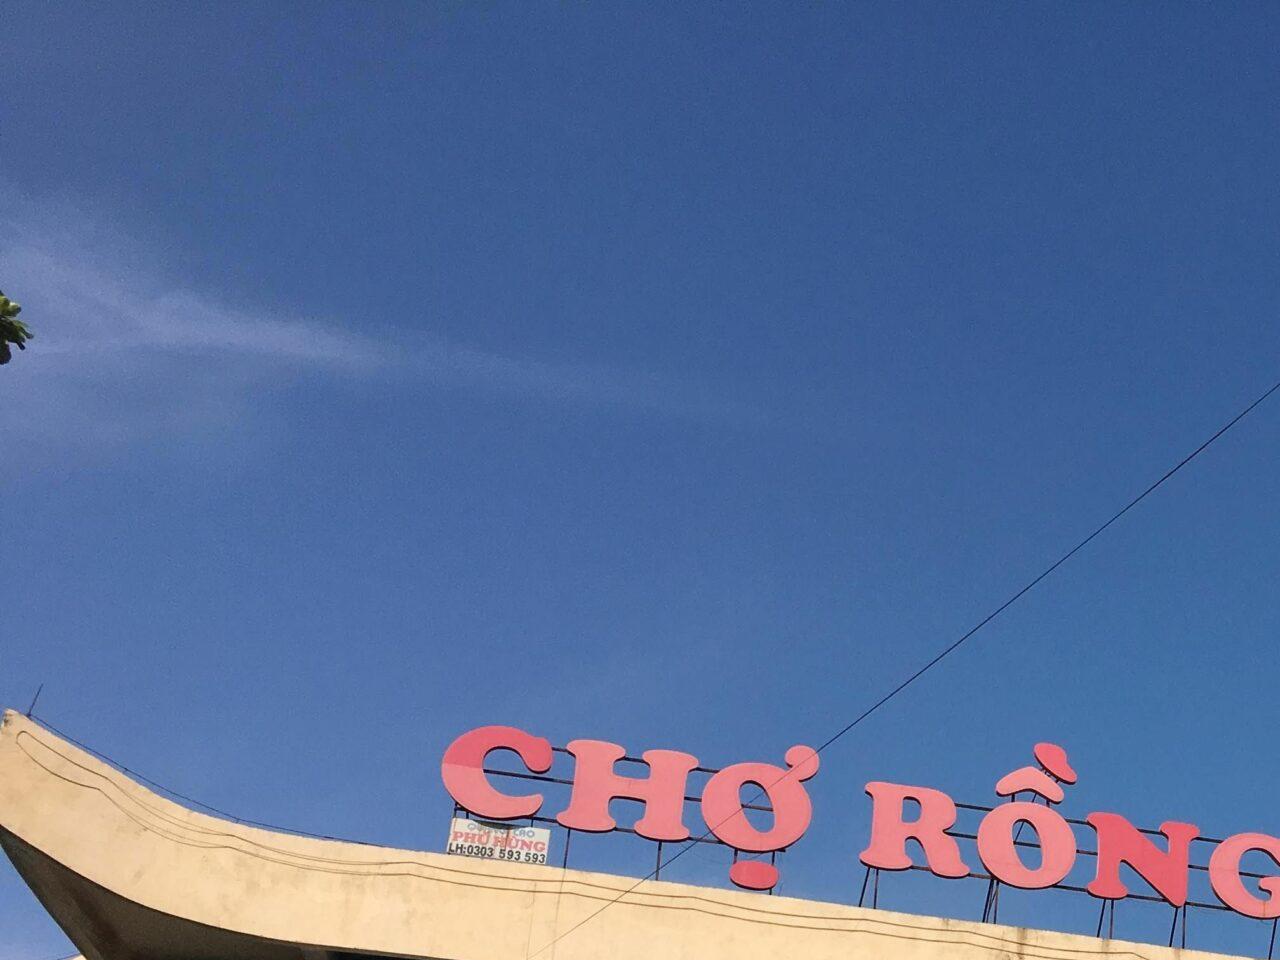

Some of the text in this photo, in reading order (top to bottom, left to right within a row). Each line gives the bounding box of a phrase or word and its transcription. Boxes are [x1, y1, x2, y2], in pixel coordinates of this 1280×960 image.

[441, 725, 820, 891] CHỢ
[499, 848, 521, 861] 593
[524, 851, 546, 864] 593
